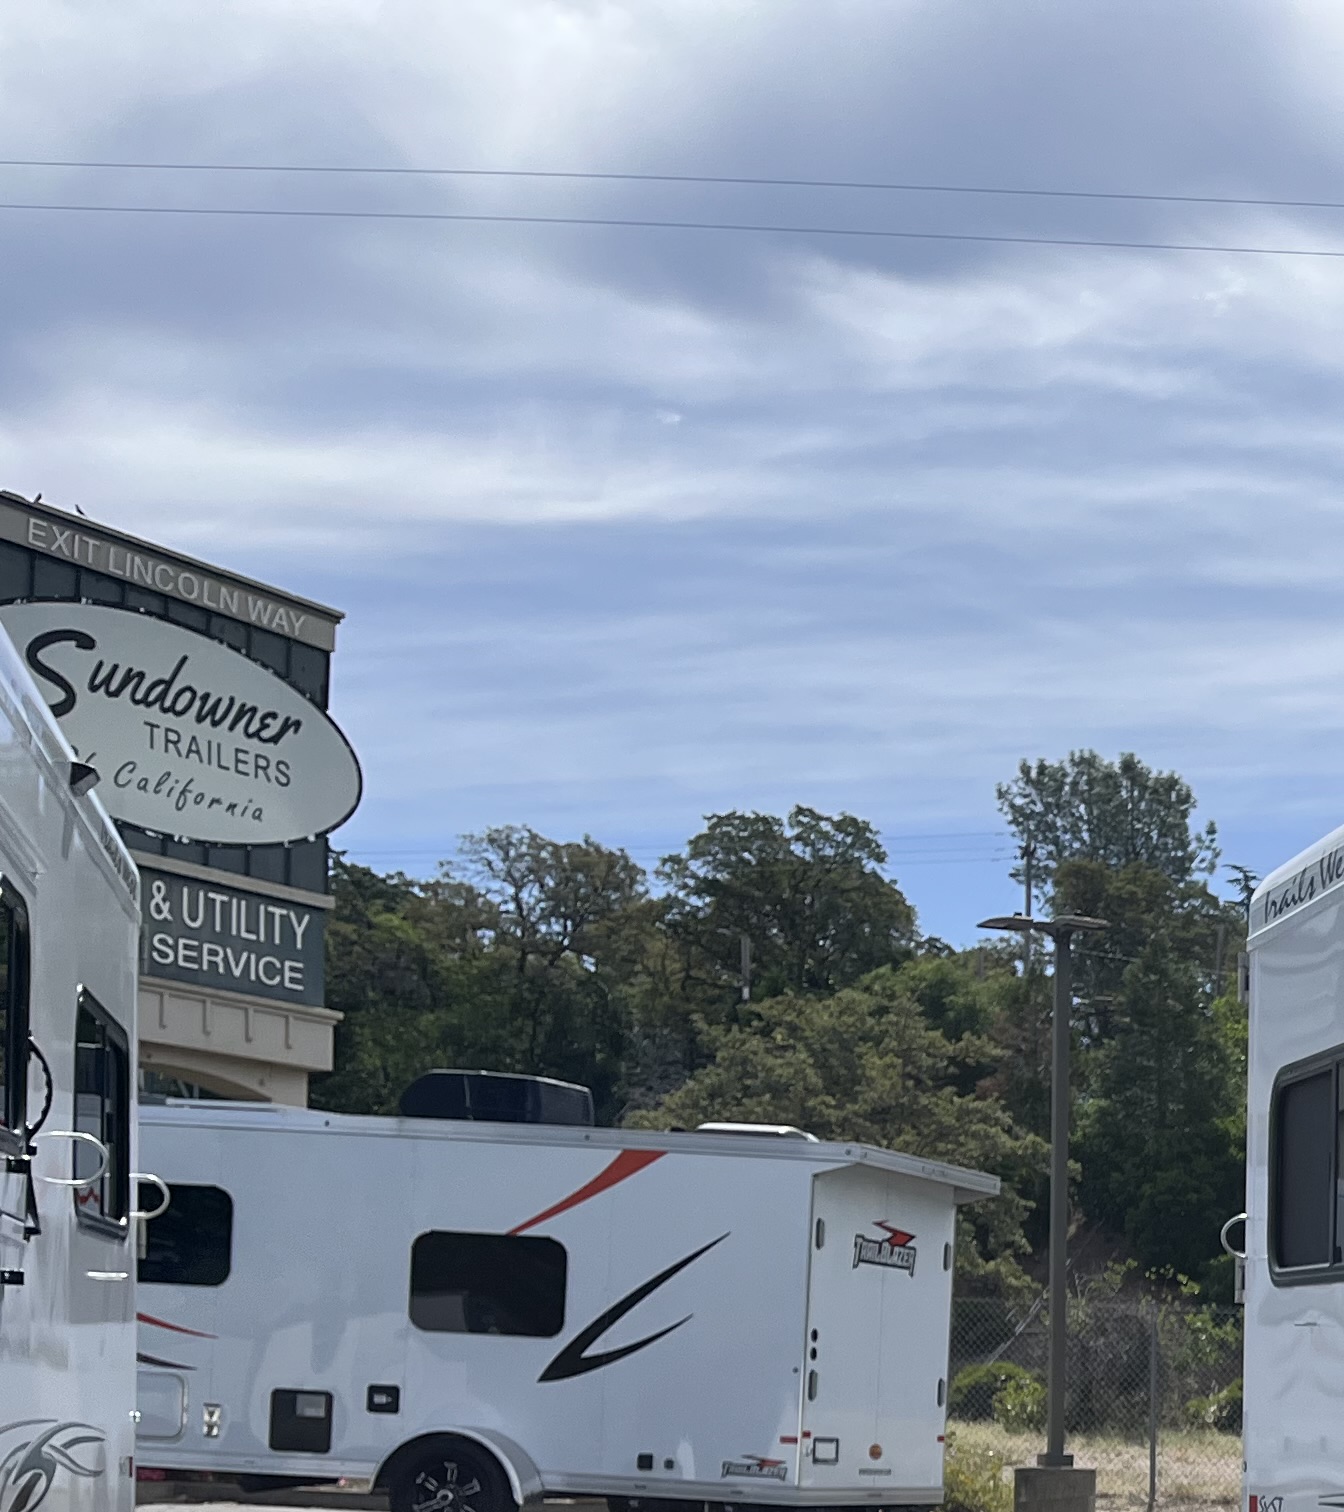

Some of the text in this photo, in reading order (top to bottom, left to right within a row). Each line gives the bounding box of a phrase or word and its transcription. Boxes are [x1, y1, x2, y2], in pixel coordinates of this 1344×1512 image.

[28, 517, 306, 637] EXIT LINCOLN WAY
[25, 629, 303, 746] Sundowner
[143, 720, 292, 788] TRAILERS
[113, 760, 263, 823] California
[150, 879, 311, 951] & UTILITY
[151, 932, 305, 992] SERVICE
